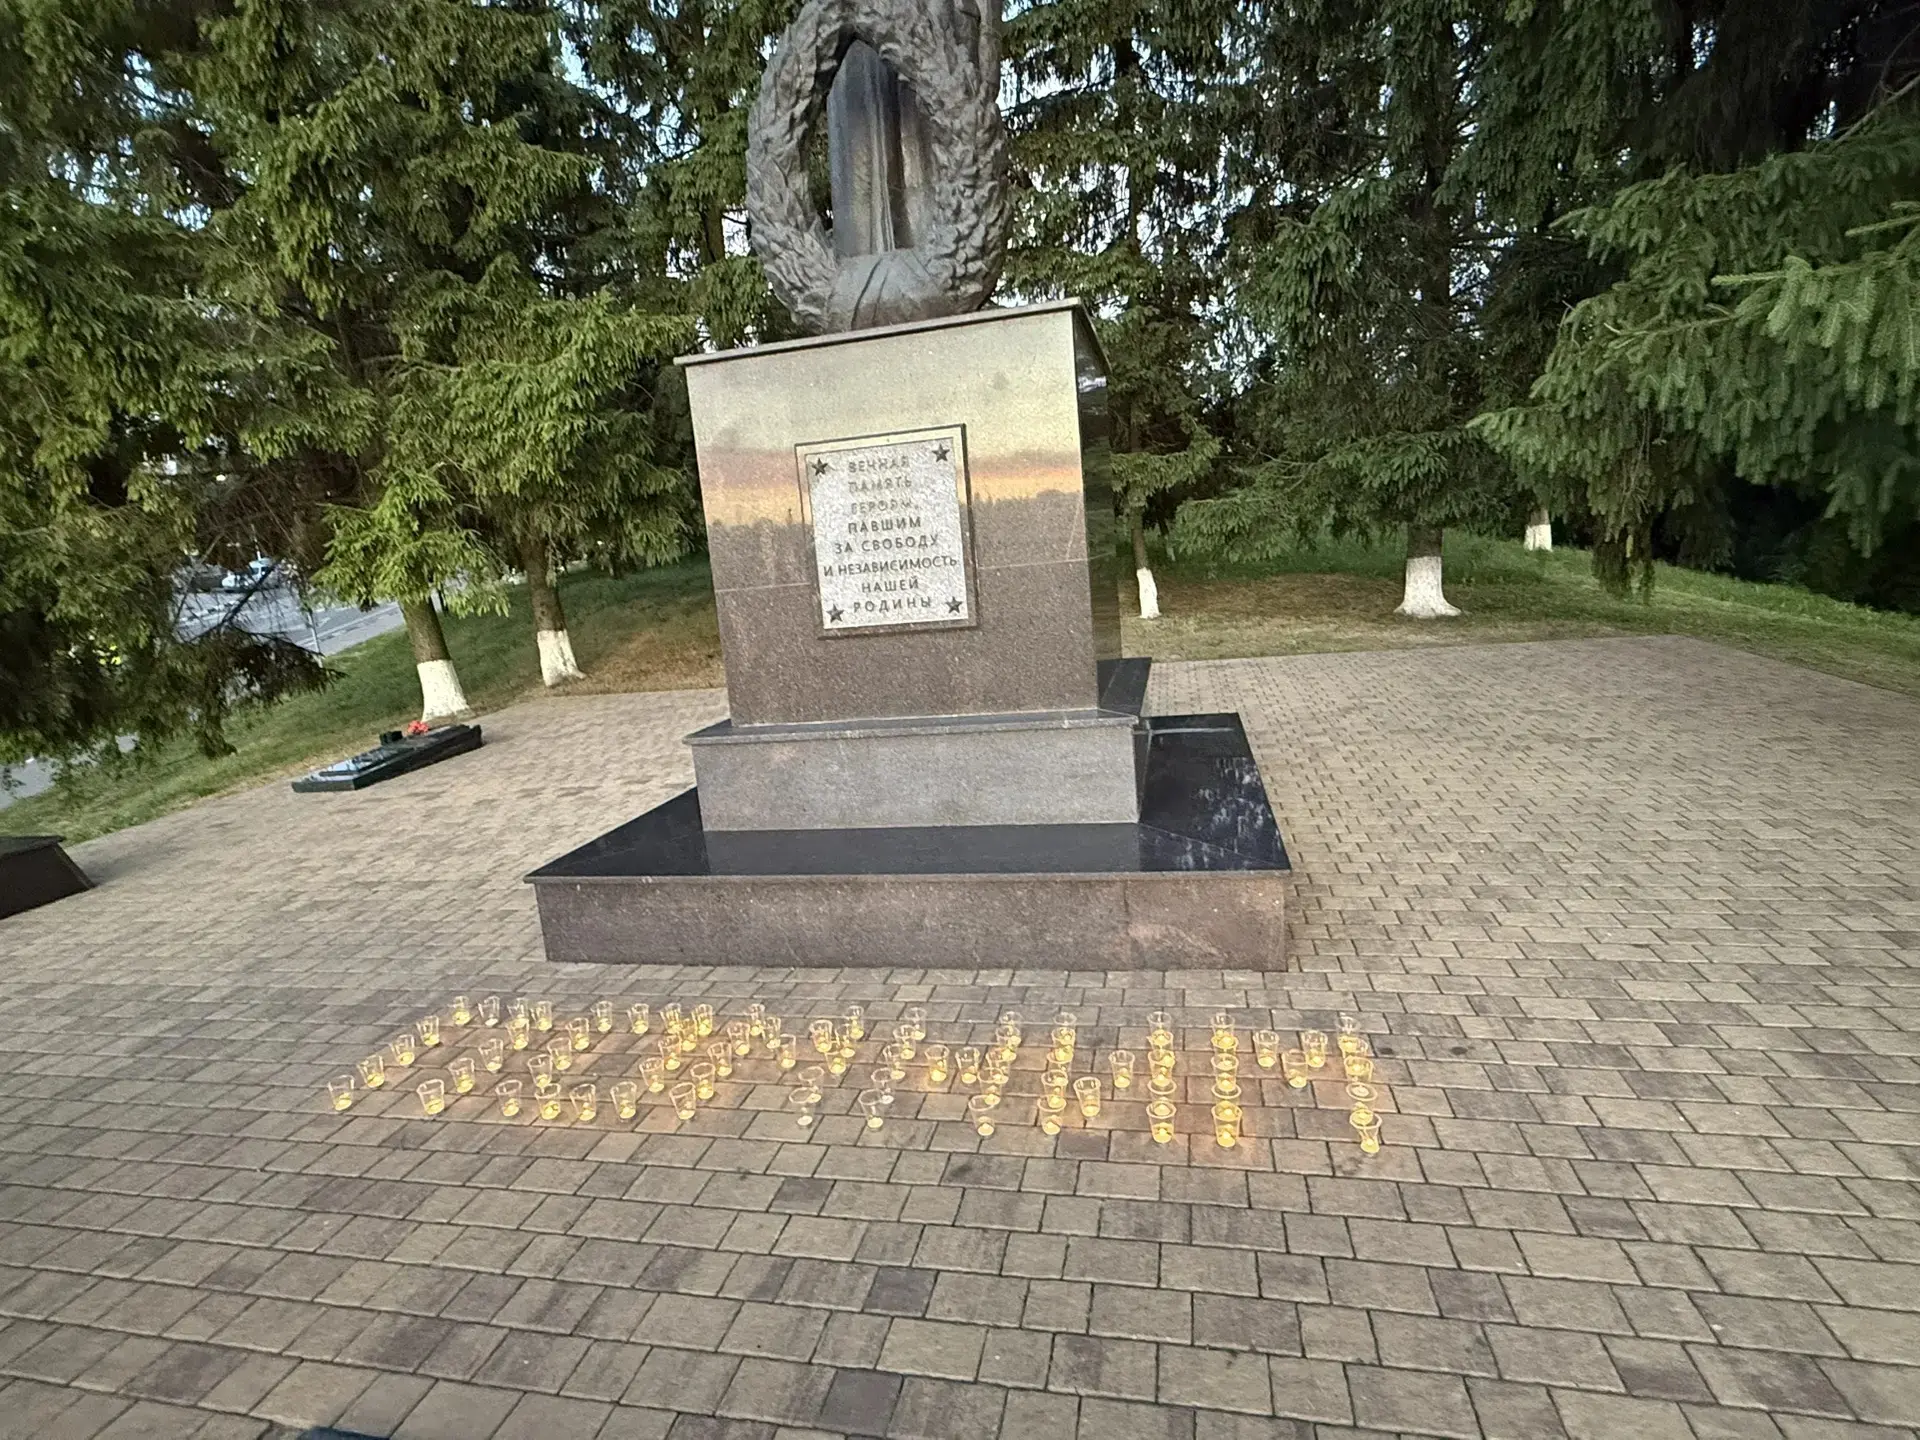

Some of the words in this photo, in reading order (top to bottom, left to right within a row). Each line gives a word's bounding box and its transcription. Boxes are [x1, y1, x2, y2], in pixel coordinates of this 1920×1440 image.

[848, 516, 922, 534] ПАВШИМ
[835, 542, 854, 554] ЗА
[861, 534, 938, 552] СВОБОДУ
[823, 566, 833, 577] И
[838, 556, 957, 575] НЕЗАВИСИМОСТЬ
[862, 576, 919, 593] НАШЕЙ
[853, 598, 931, 613] РОДИНЫ
